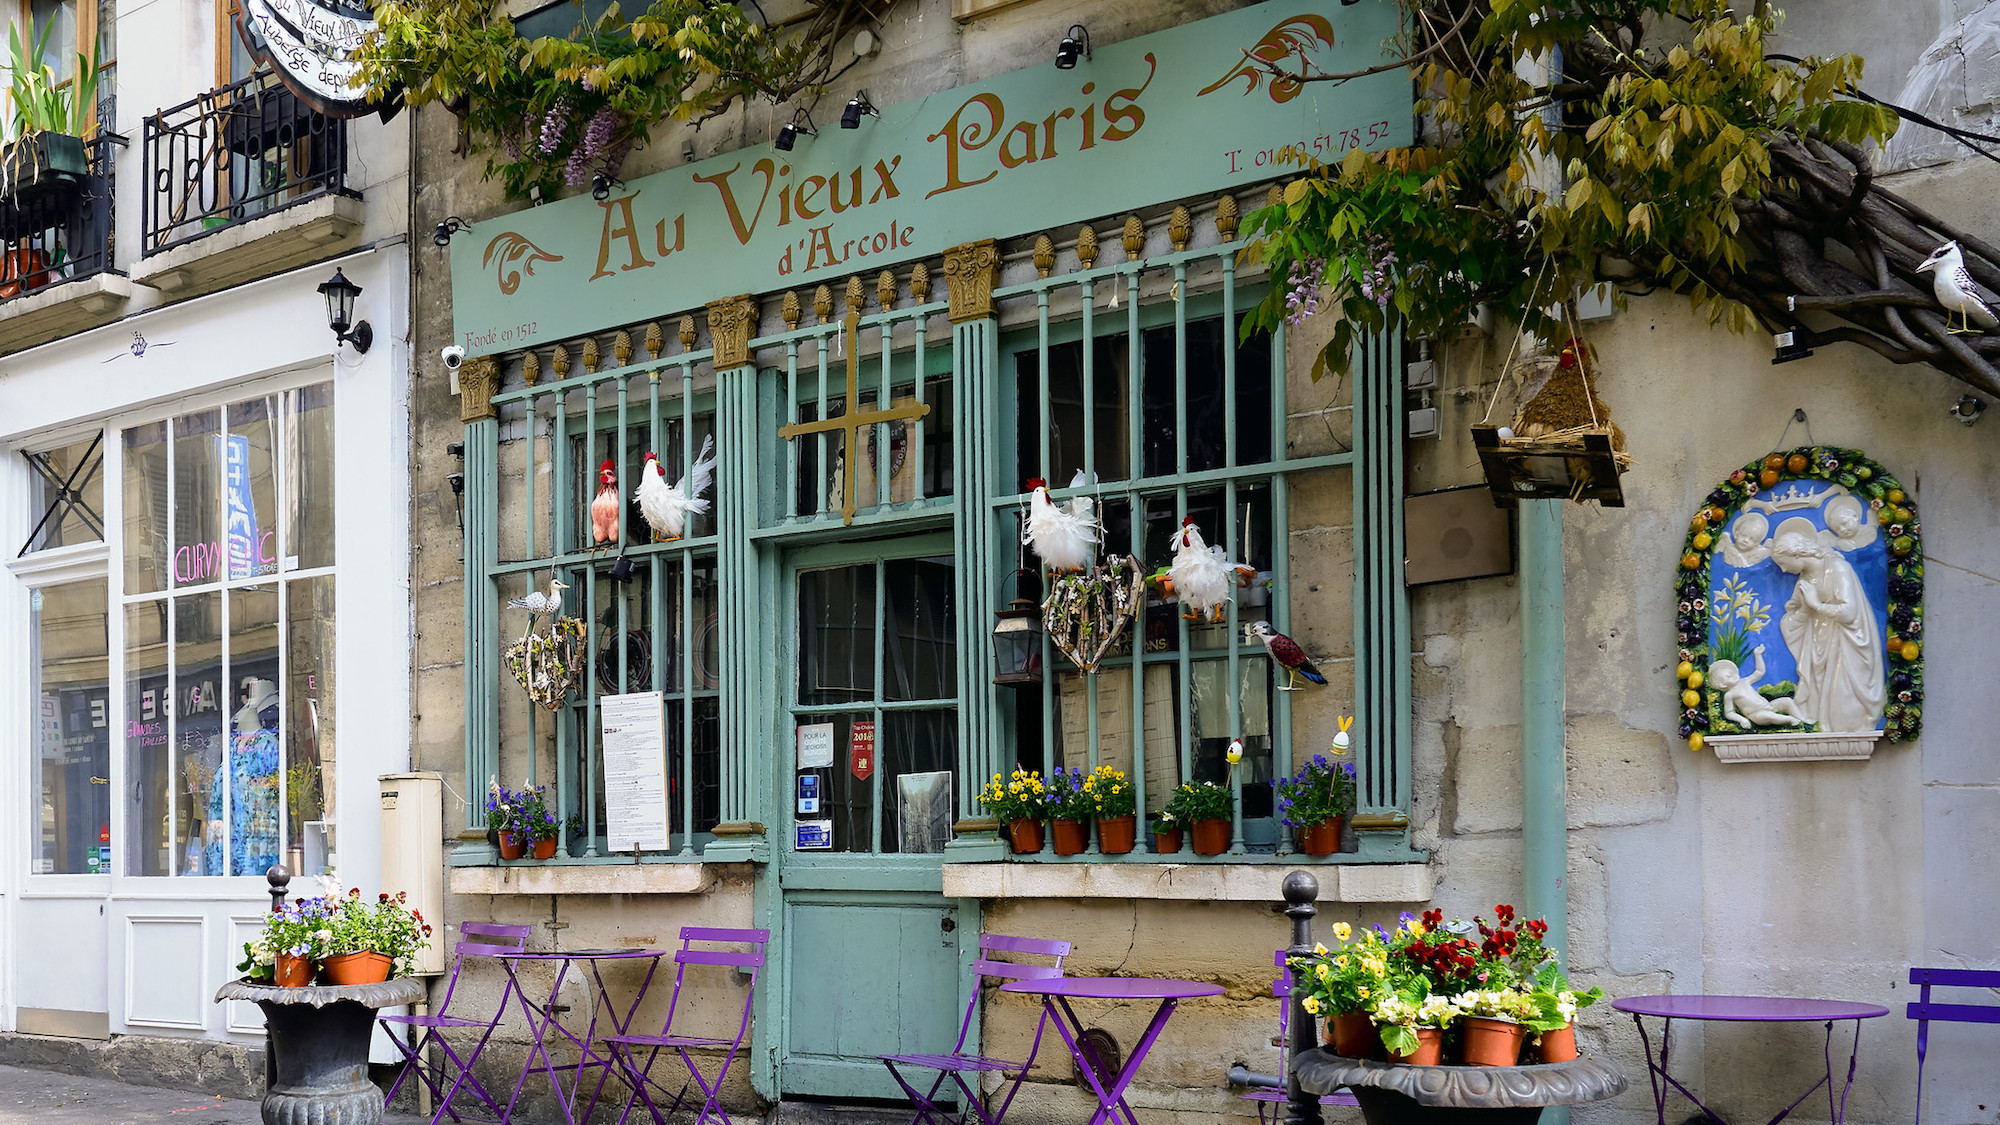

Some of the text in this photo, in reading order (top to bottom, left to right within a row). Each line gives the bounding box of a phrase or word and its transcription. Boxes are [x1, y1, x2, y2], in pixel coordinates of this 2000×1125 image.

[256, 14, 310, 73] Auberge
[588, 52, 1157, 283] Au Vieux Paris
[1255, 148, 1274, 167] 01
[1339, 128, 1361, 153] 78
[1366, 121, 1390, 147] 52
[778, 219, 915, 276] d'Arcole
[463, 321, 538, 356] Fondé en 1512
[174, 541, 223, 583] CURVY
